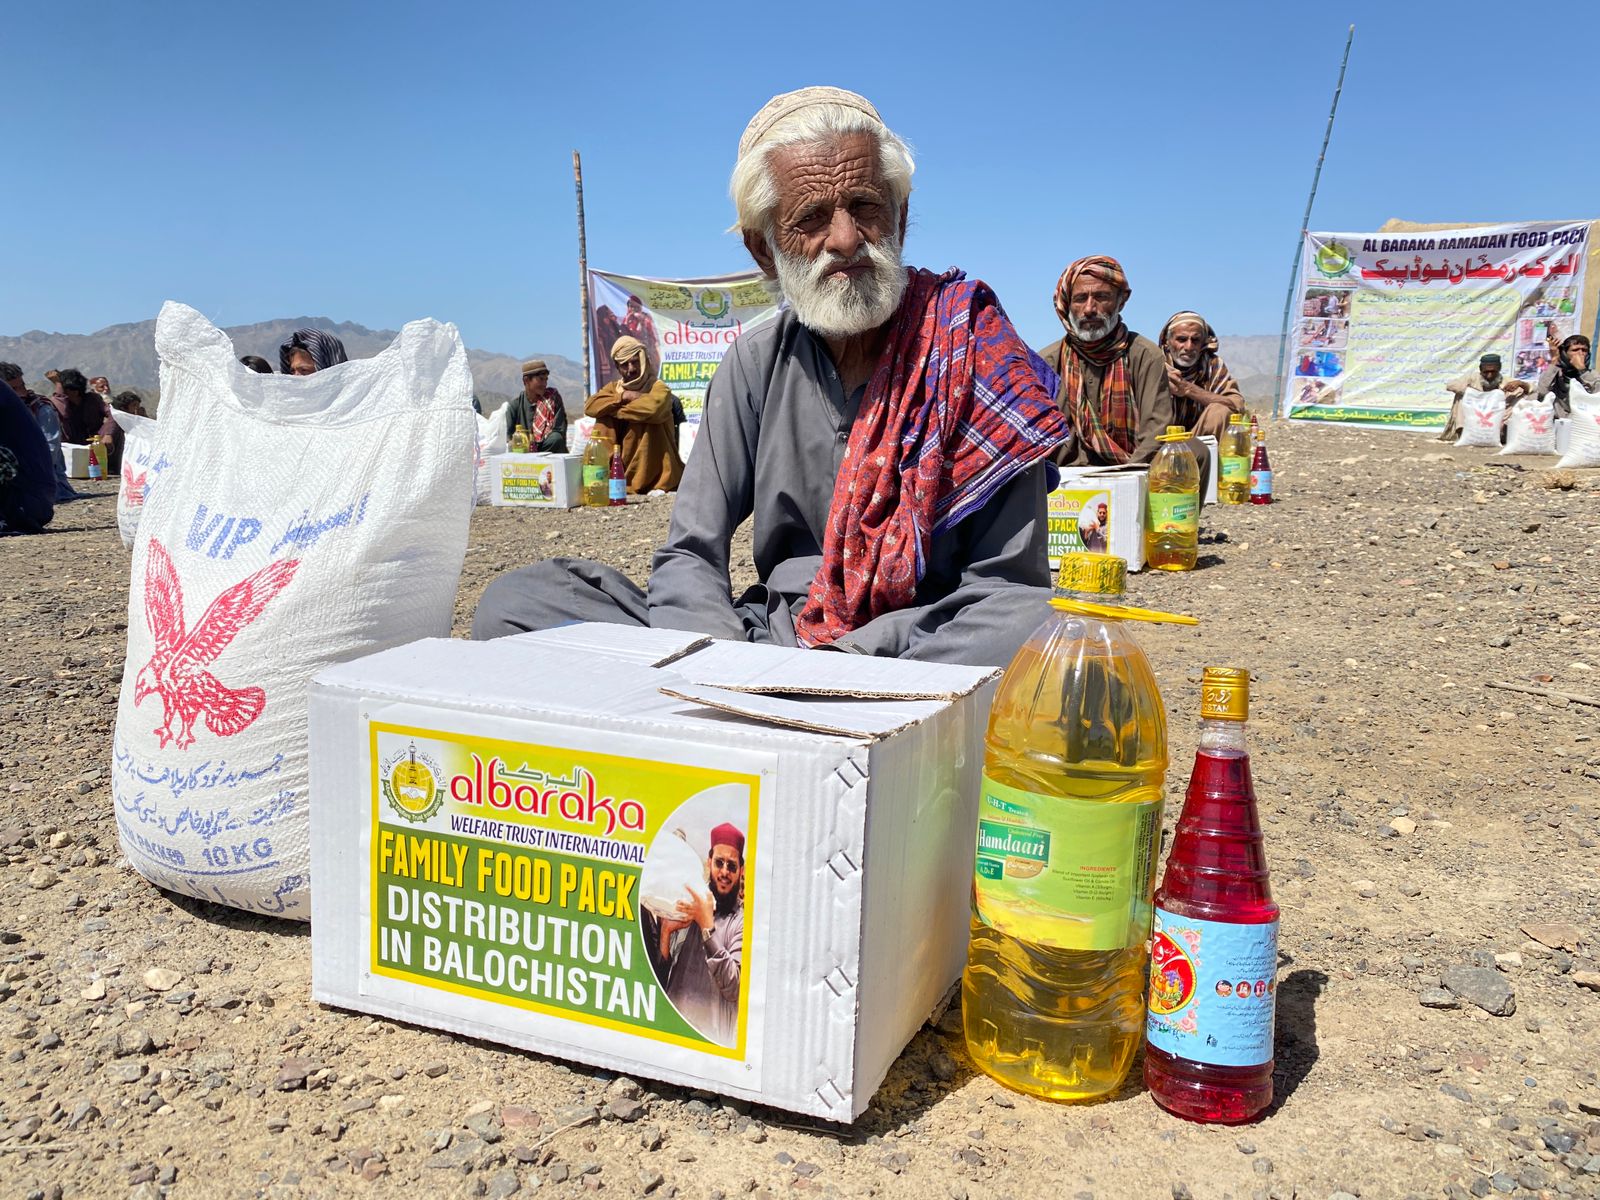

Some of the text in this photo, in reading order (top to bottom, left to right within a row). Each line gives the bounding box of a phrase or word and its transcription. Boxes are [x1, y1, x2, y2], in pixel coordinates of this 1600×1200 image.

[1362, 226, 1588, 253] AL BARAKA RAMADAN FOOD PACK
[664, 318, 742, 345] albara
[664, 351, 695, 361] WELFARE
[695, 351, 717, 360] TRUST
[662, 362, 719, 381] FAMILY FO
[186, 503, 263, 560] VIP
[1055, 518, 1077, 532] PACK
[1048, 545, 1085, 557] HISTAN
[1204, 703, 1230, 712] STAN
[450, 752, 645, 836] albaraka
[450, 814, 645, 864] WELFARE TRUST INTERNATIONAL
[379, 829, 637, 922] FAMILY FOOD PACK
[387, 884, 633, 971] DISTRIBUTION
[380, 926, 657, 1022] IN BALOCHISTAN
